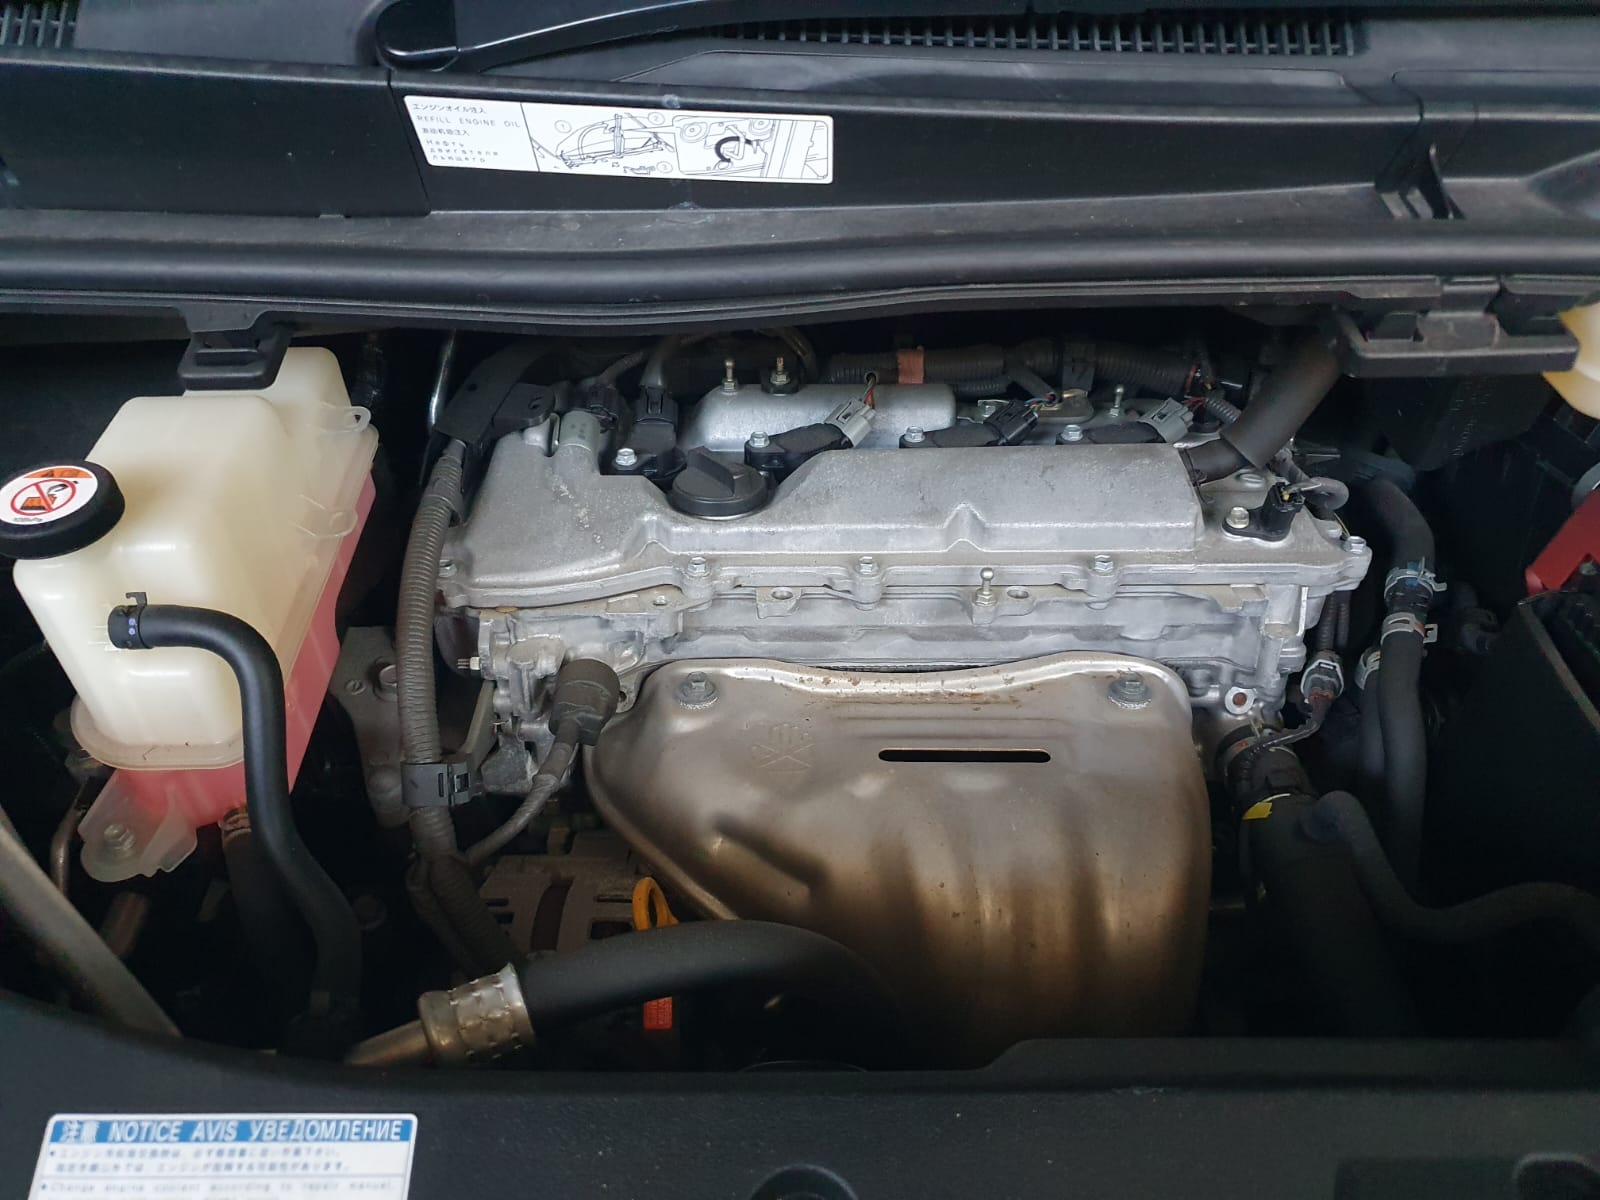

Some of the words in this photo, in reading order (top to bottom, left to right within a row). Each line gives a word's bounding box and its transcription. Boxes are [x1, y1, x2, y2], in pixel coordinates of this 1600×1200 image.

[416, 114, 451, 124] REFILL
[459, 117, 496, 127] ENGINE
[503, 120, 521, 128] OIL
[107, 1121, 183, 1143] NOTICE
[190, 1120, 238, 1142] AVIS
[249, 1119, 404, 1142] УВЕДОМЛЕНИЕ
